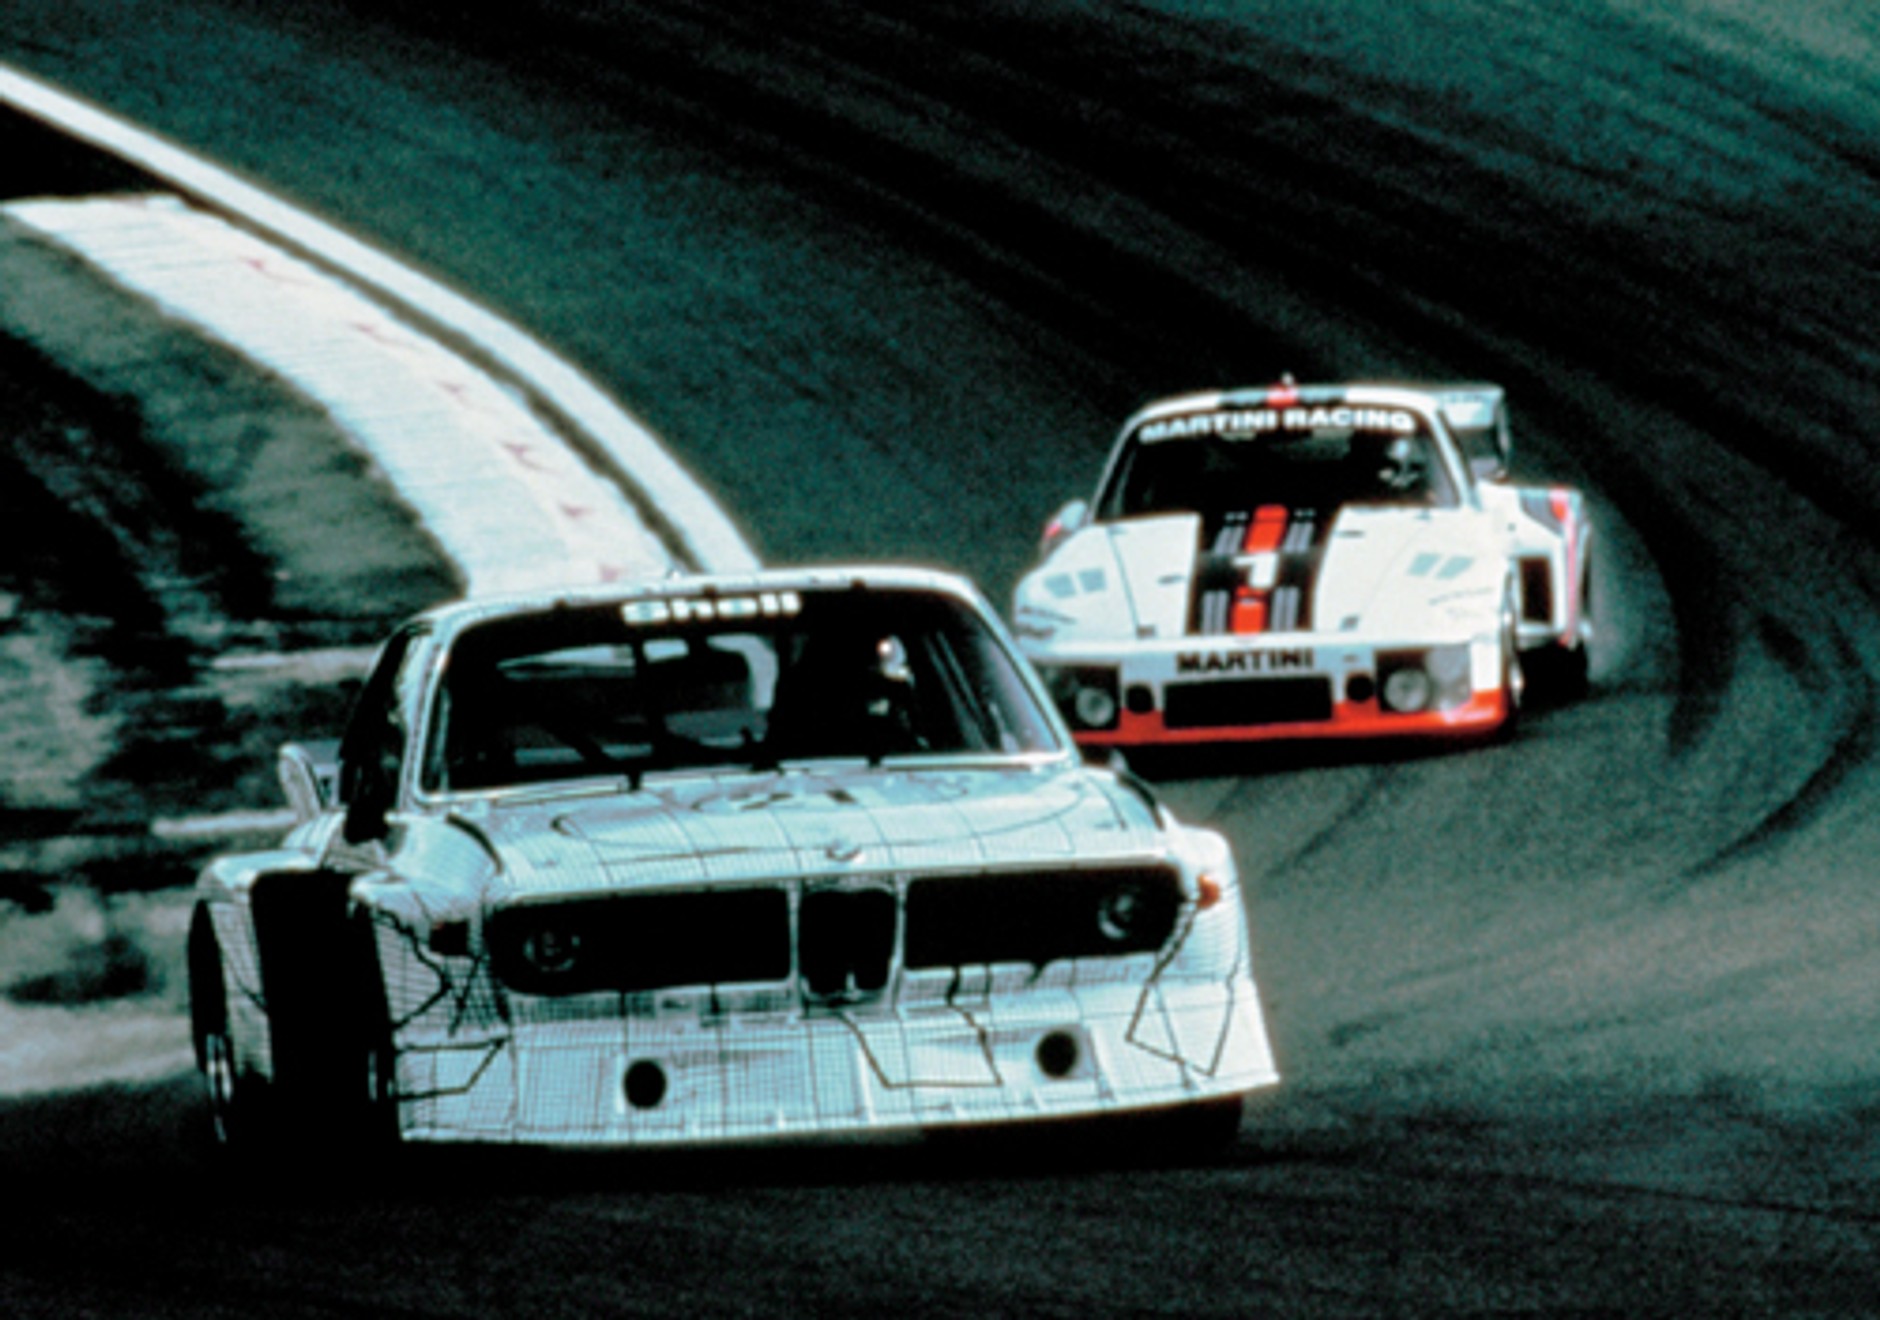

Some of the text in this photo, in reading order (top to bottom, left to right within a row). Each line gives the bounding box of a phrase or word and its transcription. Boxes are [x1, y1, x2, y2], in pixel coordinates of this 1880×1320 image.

[1139, 407, 1415, 443] MARTINI RACING
[1231, 552, 1278, 589] 1
[622, 591, 801, 624] Shell
[1176, 647, 1314, 673] MARTINI
